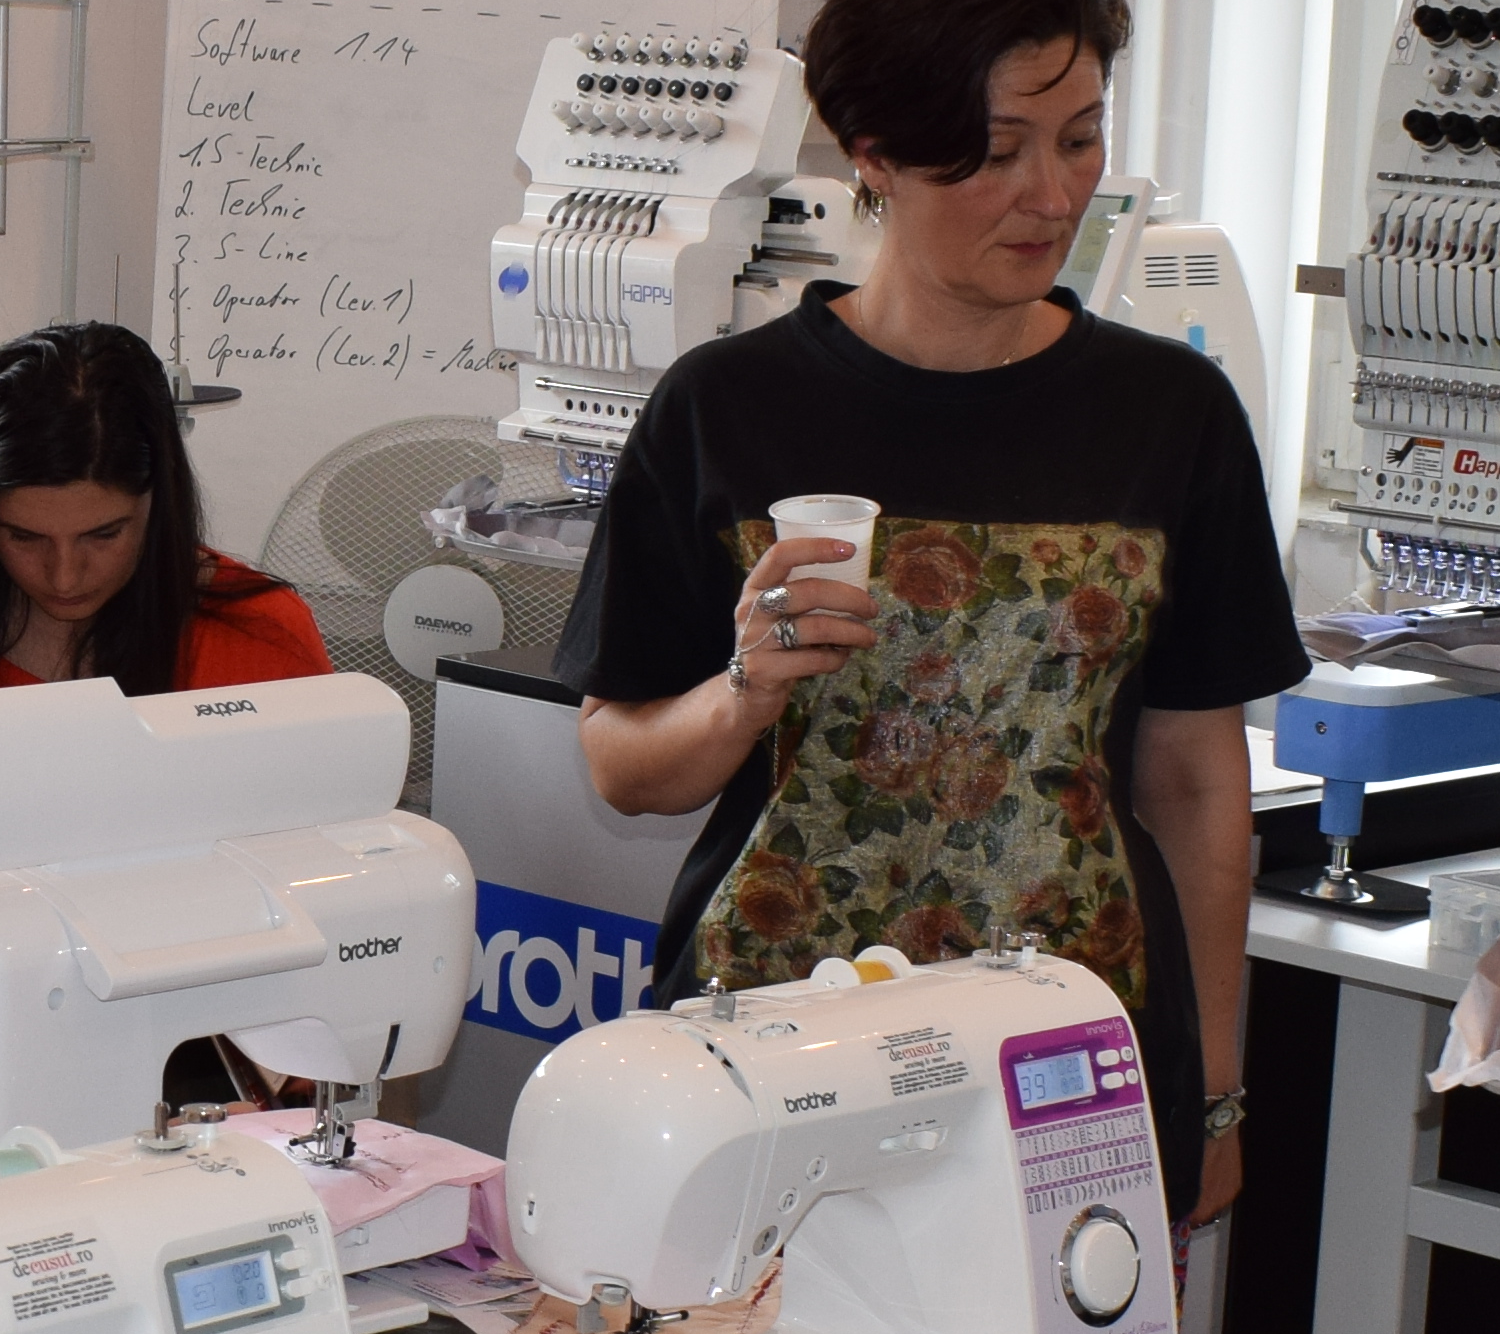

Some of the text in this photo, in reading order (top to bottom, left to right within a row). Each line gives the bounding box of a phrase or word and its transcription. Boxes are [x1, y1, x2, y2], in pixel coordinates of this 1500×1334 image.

[192, 16, 420, 66] Software 1.14
[186, 89, 254, 123] Level
[174, 178, 309, 222] 2. Technic
[212, 283, 301, 323] Operator
[207, 334, 298, 378] Operator
[414, 616, 473, 634] DAEWOO
[194, 697, 258, 719] brother
[338, 933, 402, 965] brother
[889, 1041, 950, 1063] decusut.ro
[784, 1088, 838, 1114] brother
[1019, 1073, 1047, 1103] 39
[12, 1249, 94, 1278] decusut.ro
[32, 1275, 58, 1287] sewing
